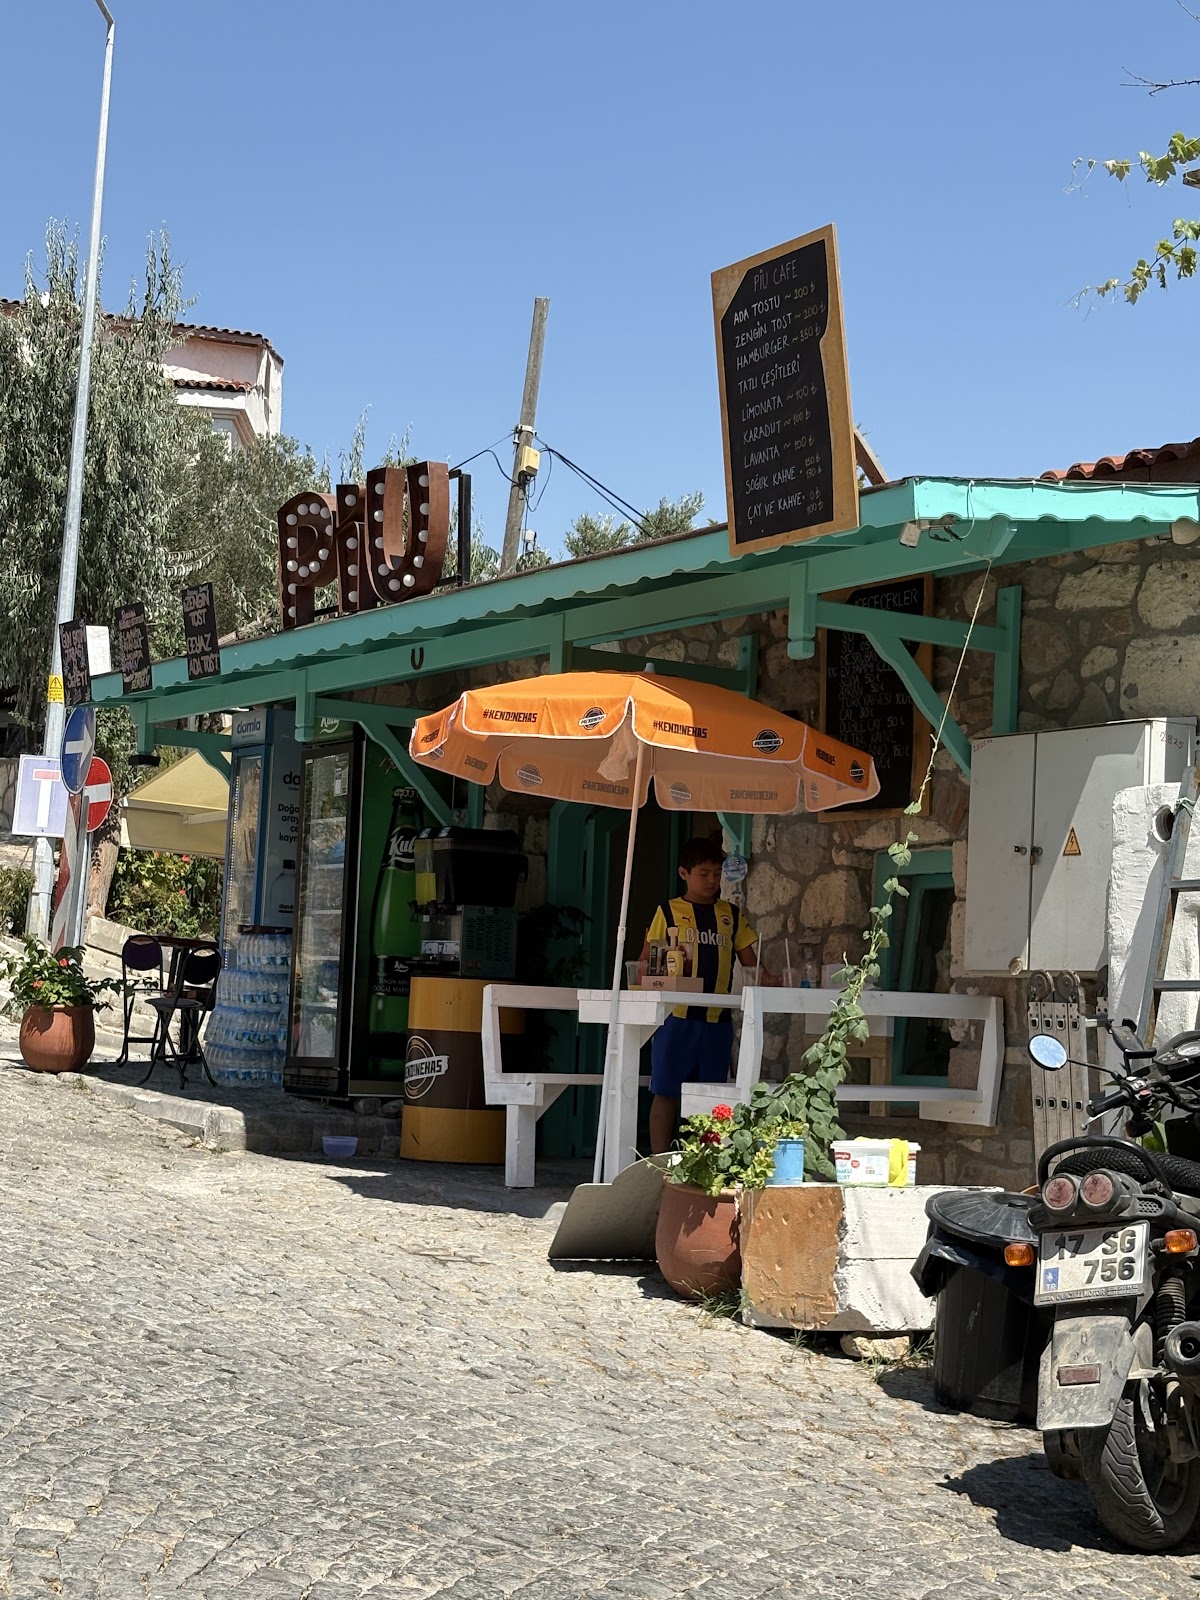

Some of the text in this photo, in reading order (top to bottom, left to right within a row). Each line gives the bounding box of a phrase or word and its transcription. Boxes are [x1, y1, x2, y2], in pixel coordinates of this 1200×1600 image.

[773, 260, 798, 284] CAFE
[734, 308, 749, 325] ADA
[752, 296, 780, 316] TOSTU
[736, 322, 767, 348] ZENGİN
[772, 312, 792, 330] TOST
[736, 335, 789, 370] HAMBURGER
[738, 354, 800, 394] TATLI ÇEŞİTLERİ
[742, 396, 783, 422] LİMONATA
[796, 386, 808, 400] 100
[743, 420, 782, 445] KARADUT
[744, 445, 780, 468] LAVANTA
[746, 474, 768, 494] SOĞUK
[772, 466, 796, 486] KAHVE
[748, 502, 762, 524] ÇAY
[765, 500, 774, 516] VE
[778, 492, 802, 511] KAHVE
[188, 609, 208, 627] TOST
[201, 653, 220, 674] TOST
[237, 718, 262, 734] damla
[1160, 731, 1184, 749] 2825
[685, 927, 729, 950] Otokoç
[1054, 1229, 1136, 1260] 17 SG
[1084, 1256, 1135, 1284] 756
[1046, 1283, 1056, 1292] TR
